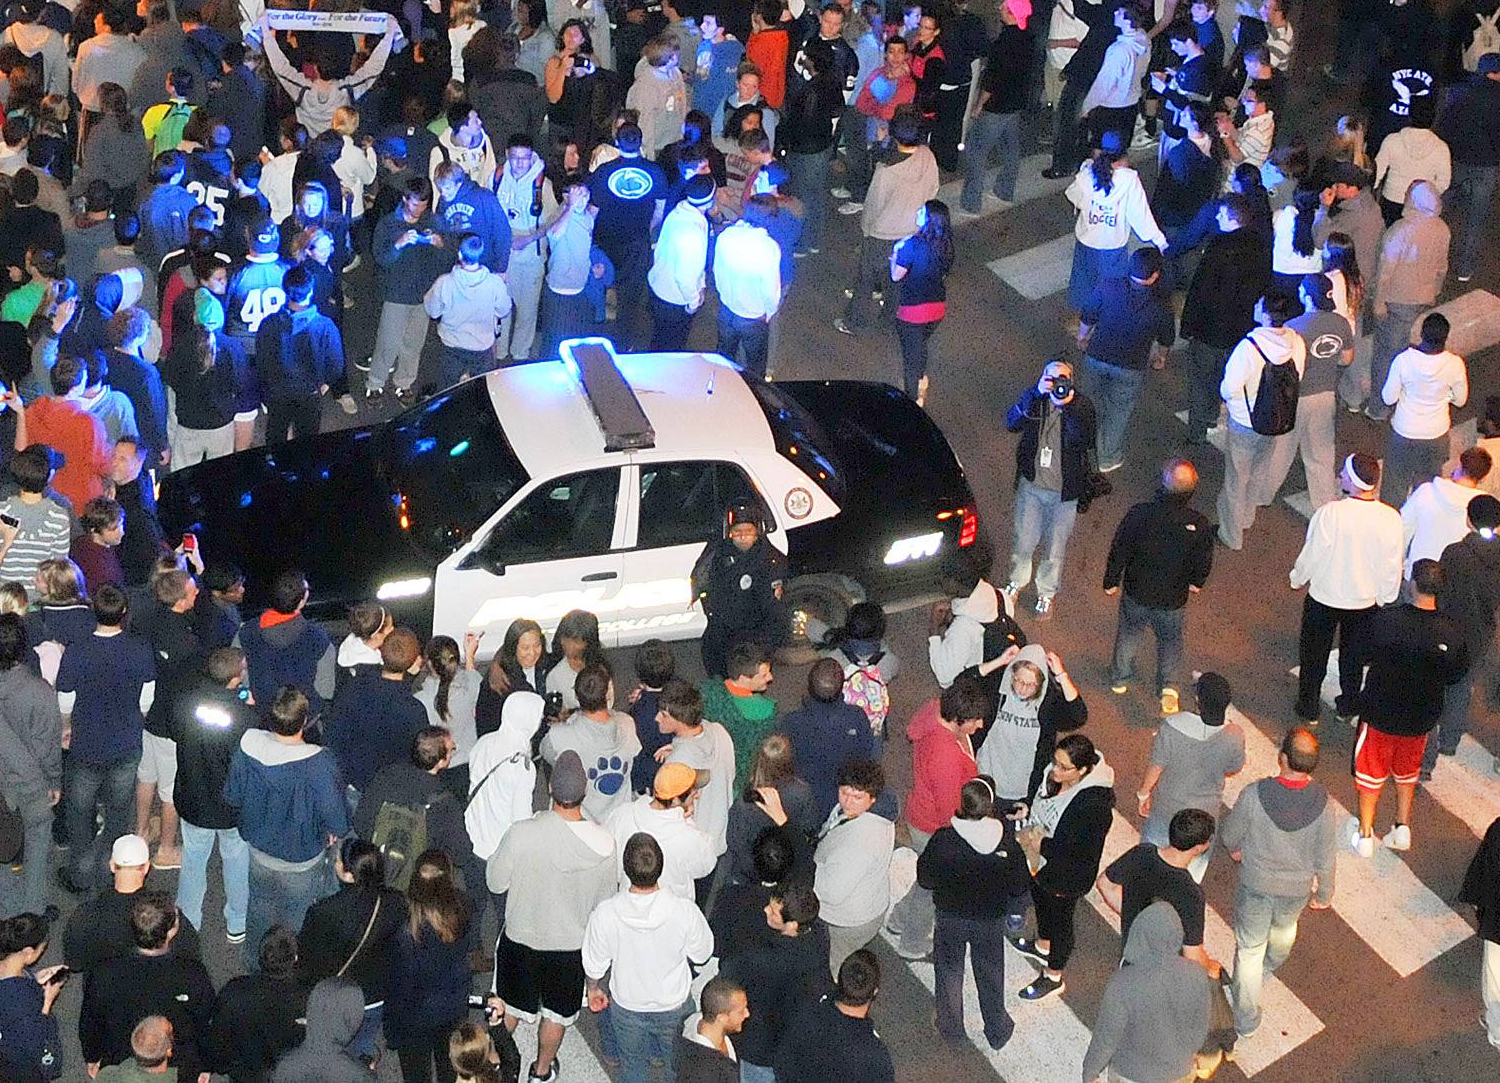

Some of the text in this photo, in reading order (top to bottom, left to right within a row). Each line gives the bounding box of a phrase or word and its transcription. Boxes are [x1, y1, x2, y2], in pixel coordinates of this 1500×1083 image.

[282, 12, 294, 20] the
[329, 13, 343, 21] For
[345, 13, 357, 21] the
[359, 14, 386, 22] Future
